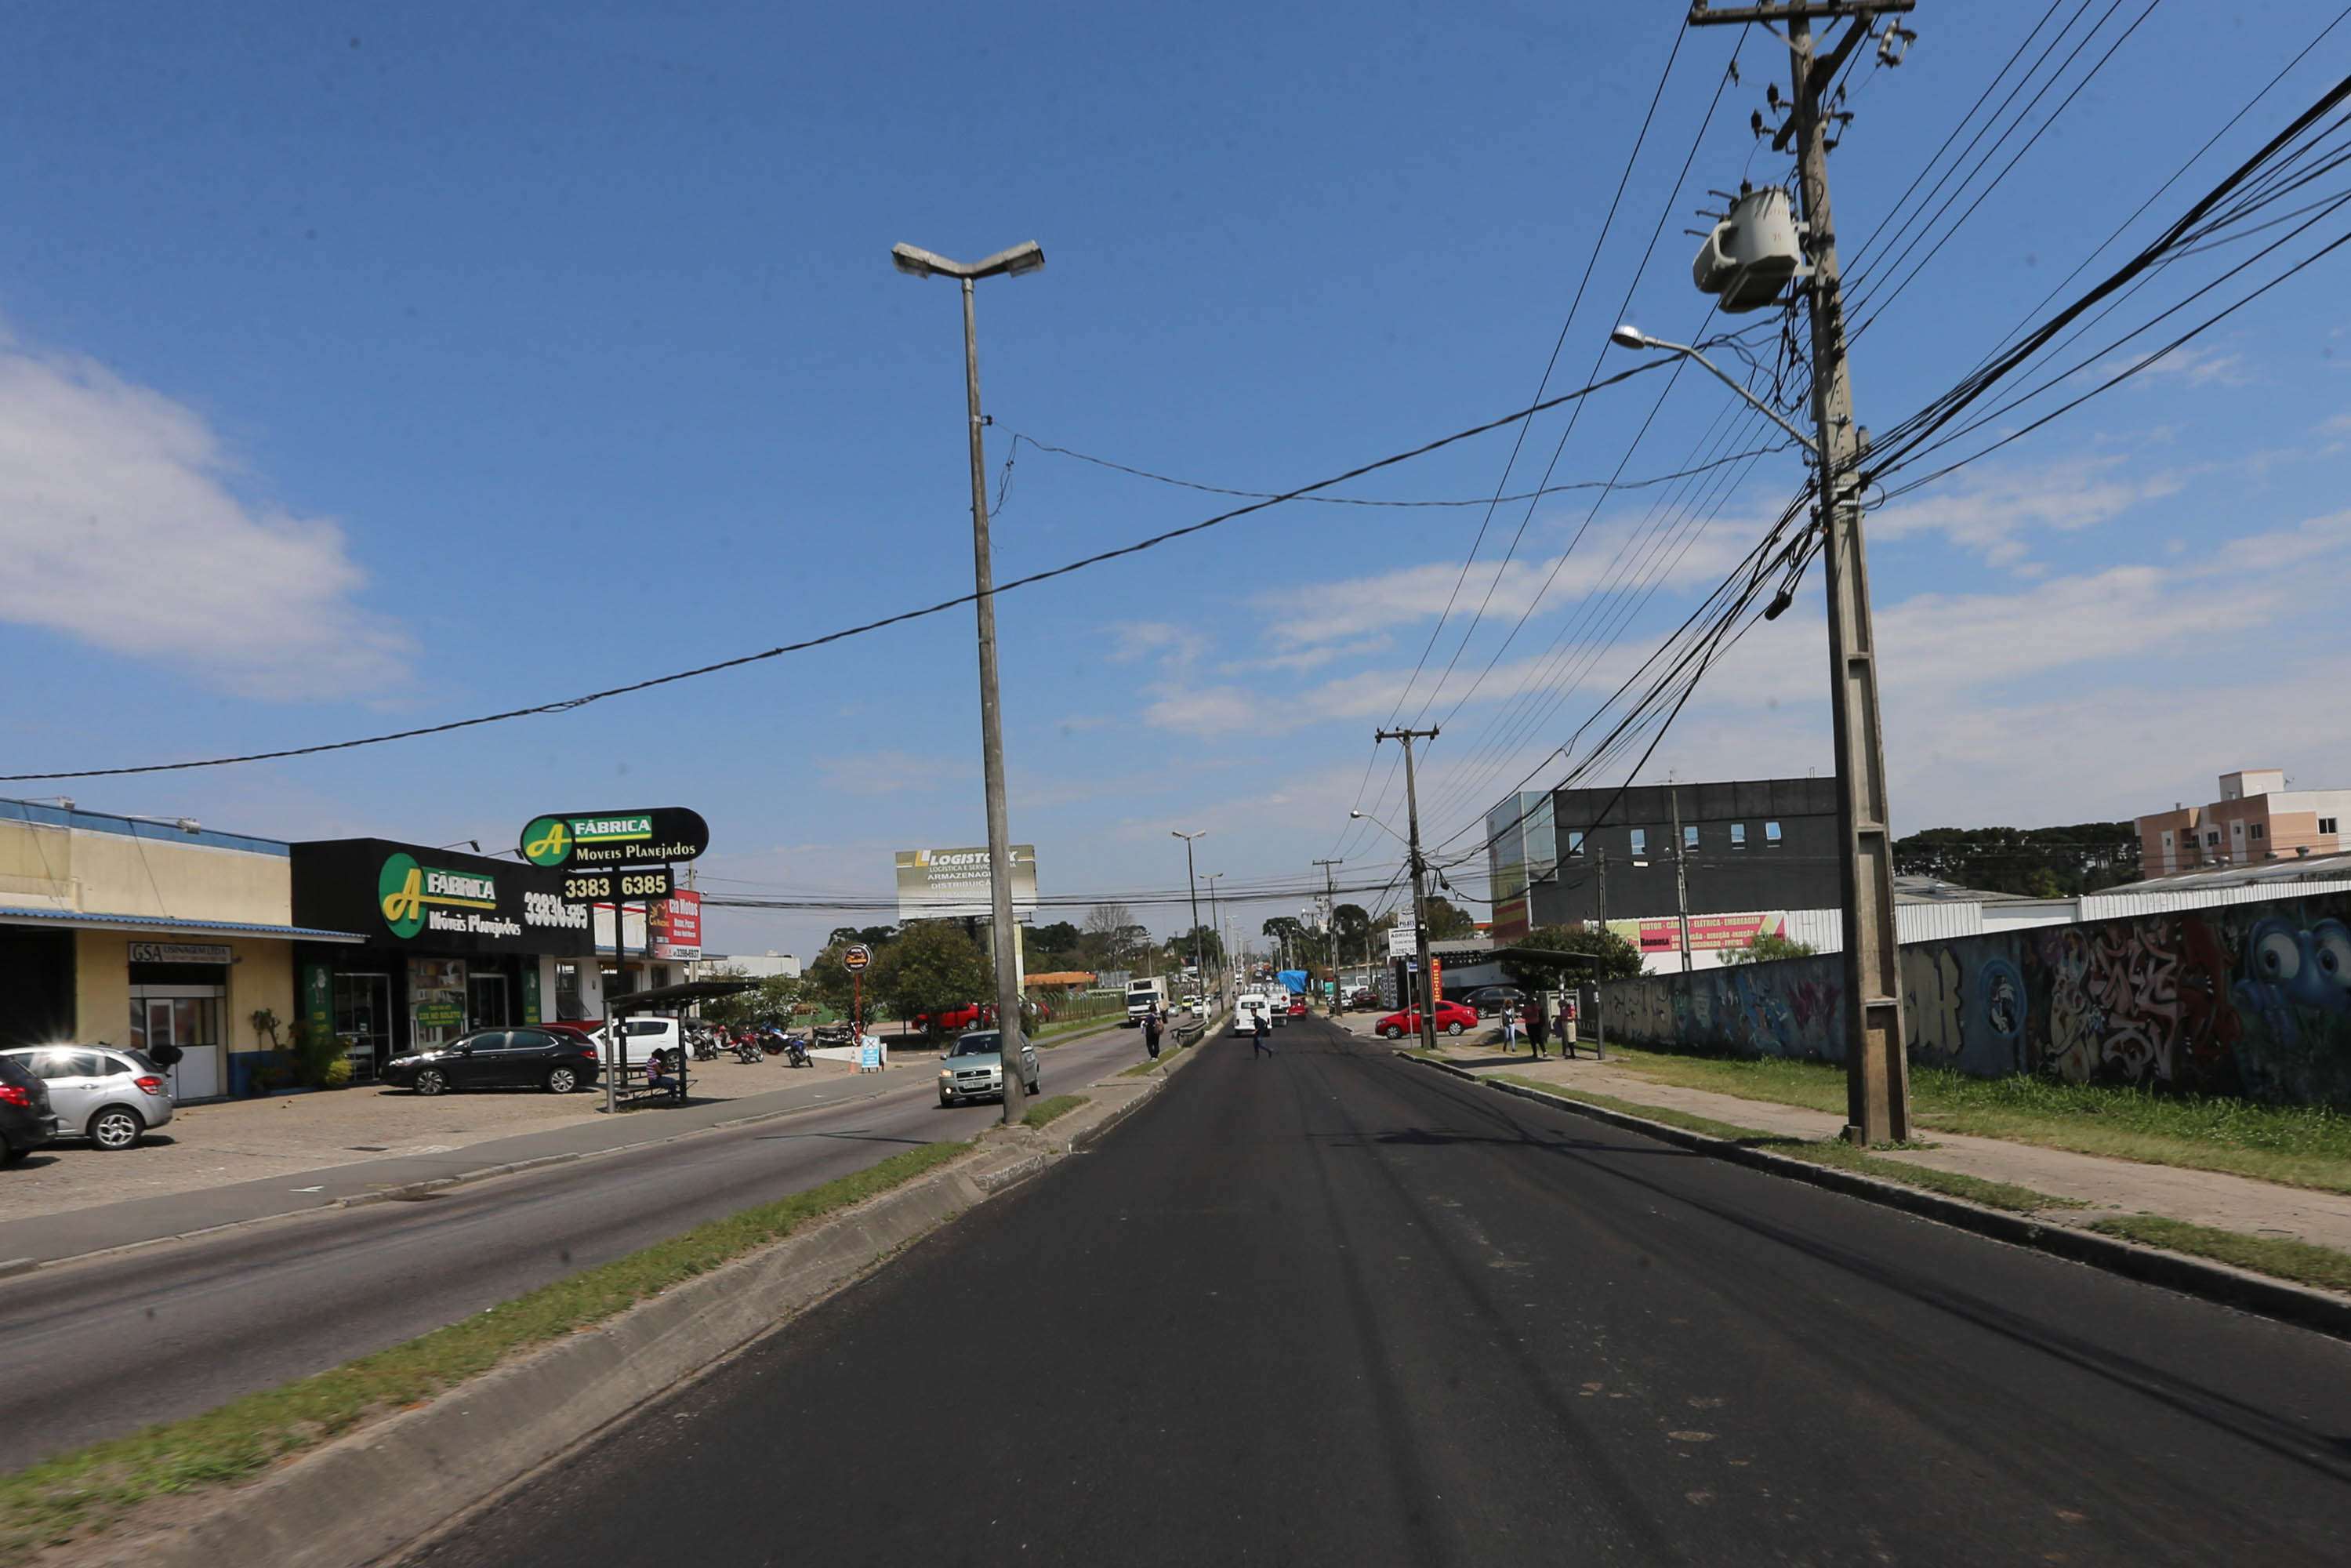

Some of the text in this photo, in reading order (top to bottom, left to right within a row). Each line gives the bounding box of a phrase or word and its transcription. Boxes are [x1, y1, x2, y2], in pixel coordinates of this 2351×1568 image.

[575, 818, 651, 835] FÁBRICA
[930, 851, 1018, 866] LOGISTOK
[427, 871, 496, 900] FÁBRICA
[564, 875, 666, 898] 3383 6385
[1641, 921, 1663, 931] MOTOR
[1693, 918, 1721, 927] ELÉTRICA
[132, 944, 163, 962] GSA
